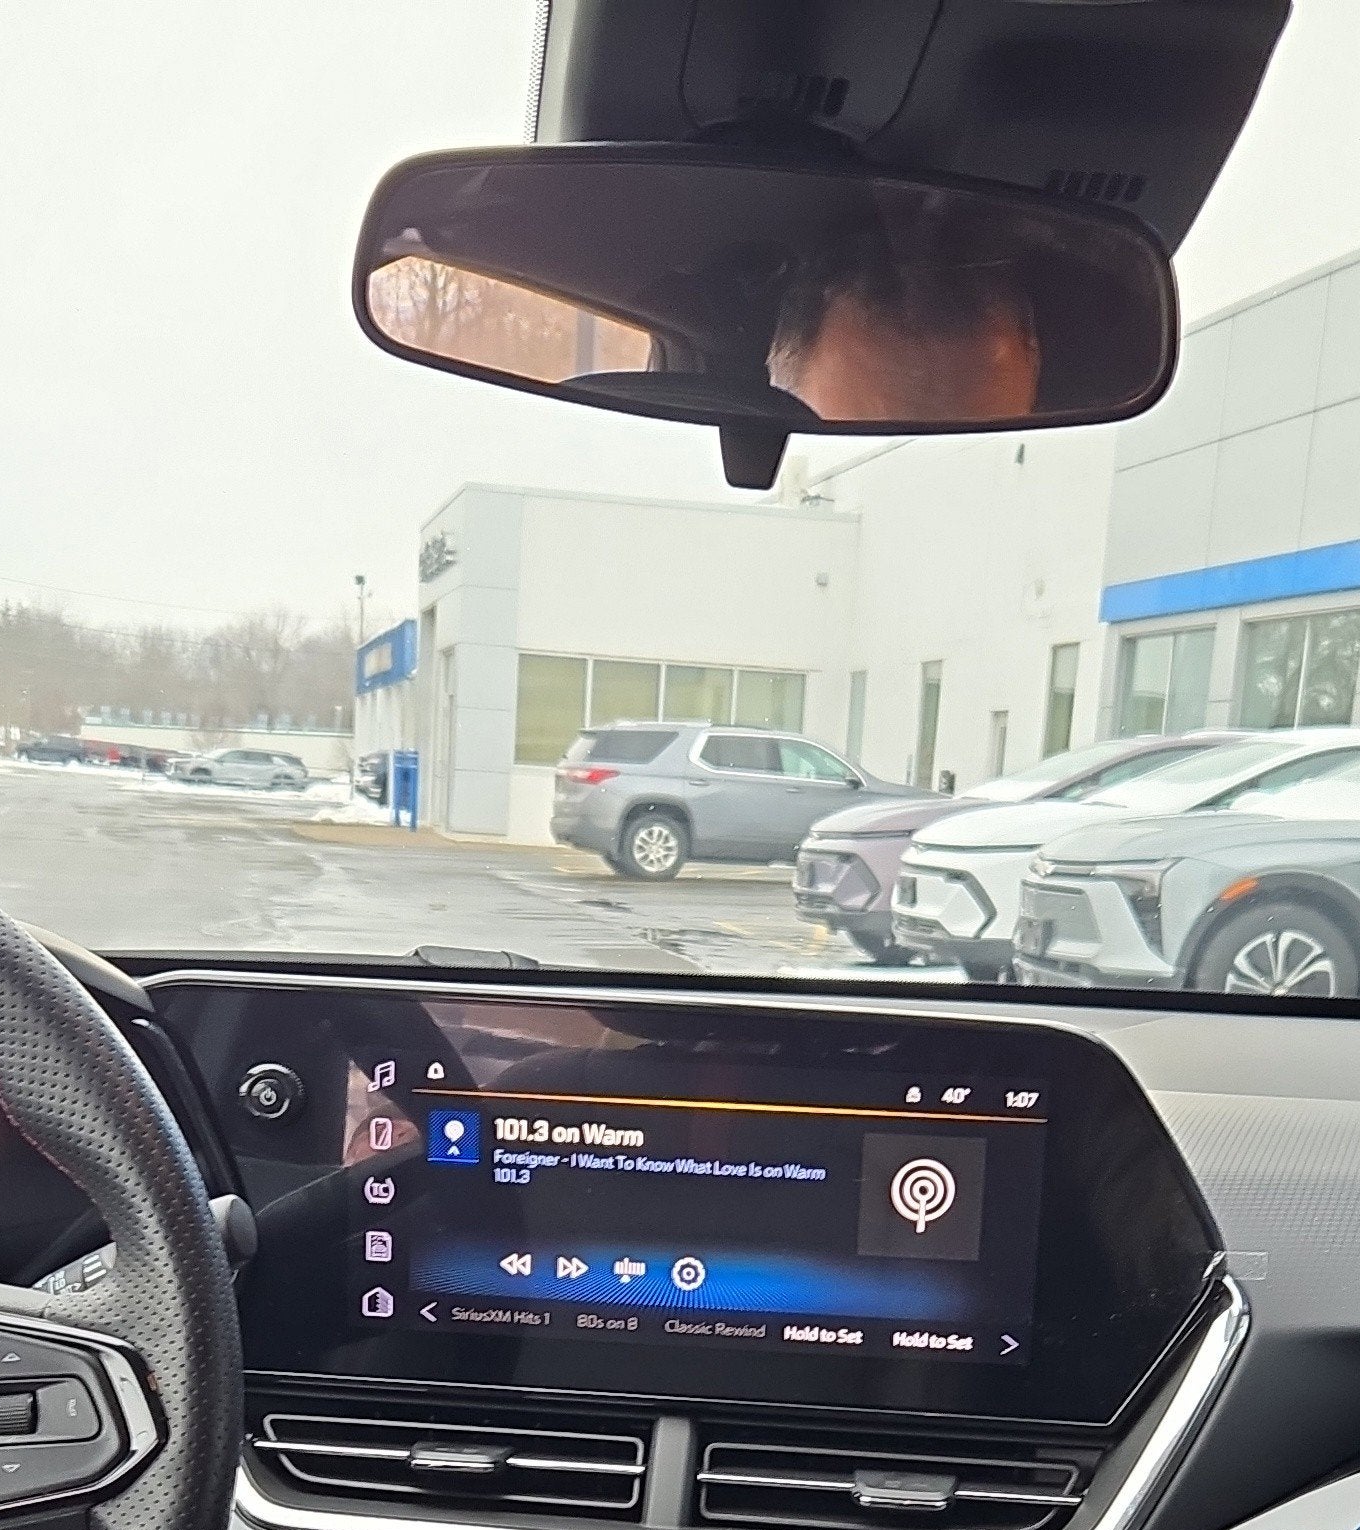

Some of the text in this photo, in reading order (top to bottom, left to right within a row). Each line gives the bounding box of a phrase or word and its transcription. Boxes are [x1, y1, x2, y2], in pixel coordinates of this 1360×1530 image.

[494, 1117, 645, 1148] 101.3 on Warm
[493, 1149, 560, 1169] Foreigner
[570, 1153, 577, 1168] I
[577, 1153, 615, 1170] Want
[616, 1154, 635, 1170] To
[636, 1156, 675, 1173] Know
[674, 1158, 712, 1175] What
[713, 1160, 747, 1177] Love
[748, 1162, 762, 1178] Is
[762, 1166, 783, 1180] on
[783, 1163, 827, 1181] Warm
[493, 1167, 531, 1184] 101.3
[451, 1306, 551, 1326] SiriusXM Hits 1
[576, 1314, 639, 1331] 80s on 8
[664, 1318, 767, 1338] Classic Rewind
[783, 1325, 864, 1345] Hold to Set
[892, 1331, 974, 1350] Hold to Set
